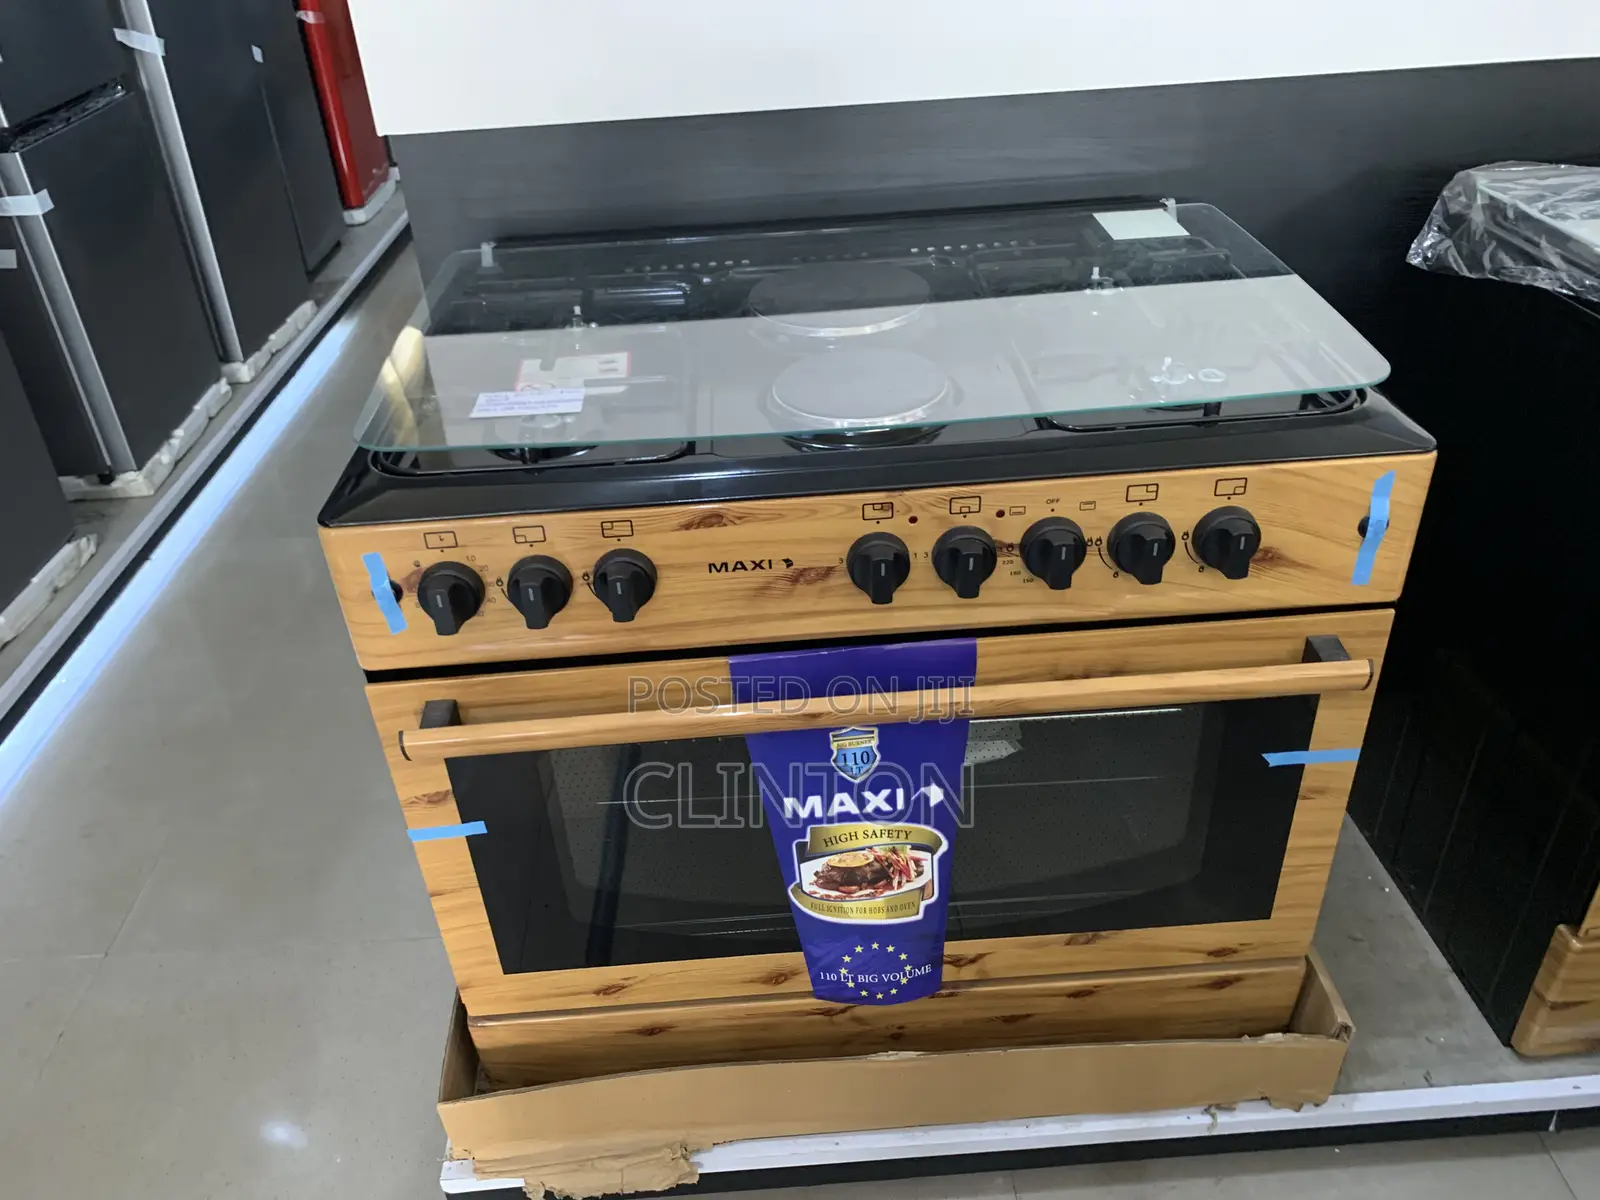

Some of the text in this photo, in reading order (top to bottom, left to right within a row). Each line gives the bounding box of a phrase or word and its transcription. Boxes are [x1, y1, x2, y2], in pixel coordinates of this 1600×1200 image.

[708, 559, 773, 574] MAXI
[838, 557, 844, 565] 3
[841, 751, 870, 766] 110
[783, 788, 905, 818] MAXI
[822, 829, 912, 848] HIGH SAFETY
[810, 900, 916, 915] FULL IGNITION FOR HOBS AND OVEN
[820, 963, 932, 984] 110 LT BIG VOLUME
